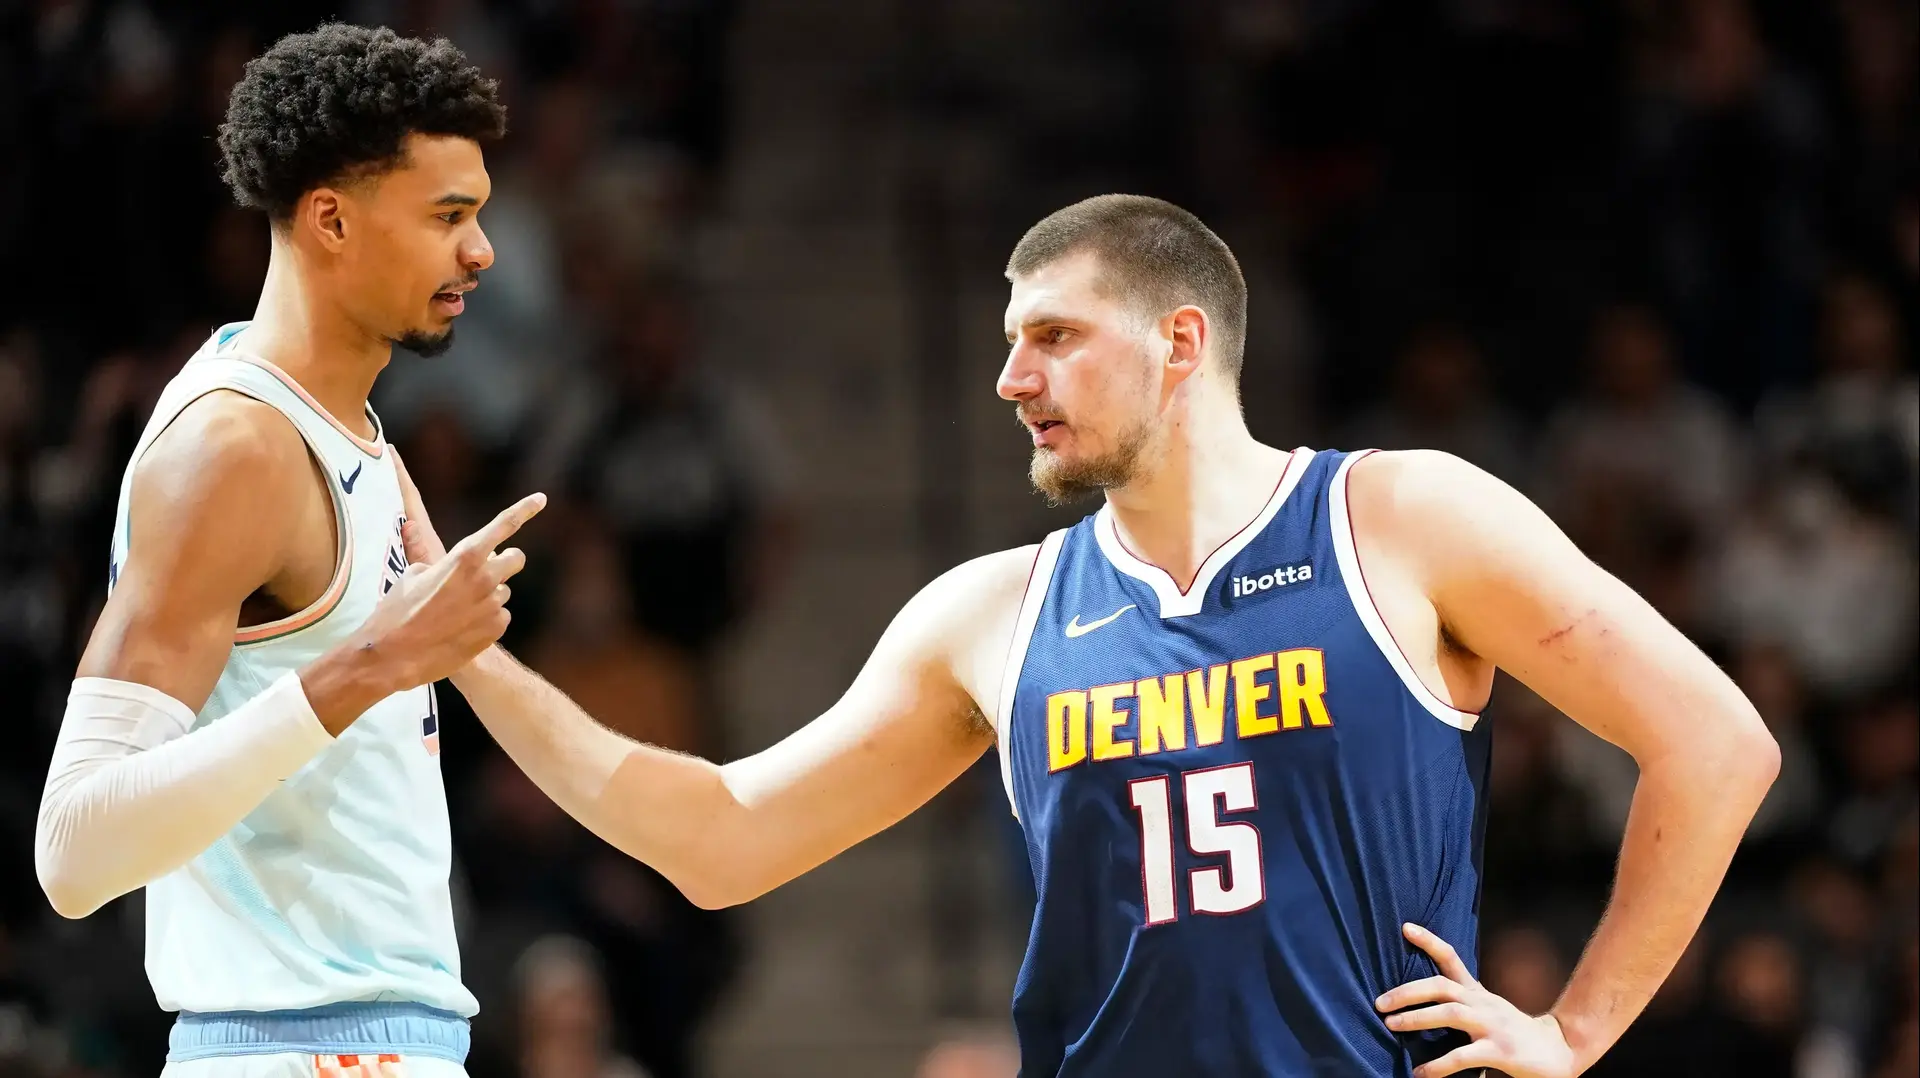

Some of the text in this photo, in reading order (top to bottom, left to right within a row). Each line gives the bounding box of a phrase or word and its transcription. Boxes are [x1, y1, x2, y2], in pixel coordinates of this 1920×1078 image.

[1233, 565, 1312, 598] ibotta
[1046, 646, 1334, 775] DENVER
[1127, 760, 1266, 928] 15
